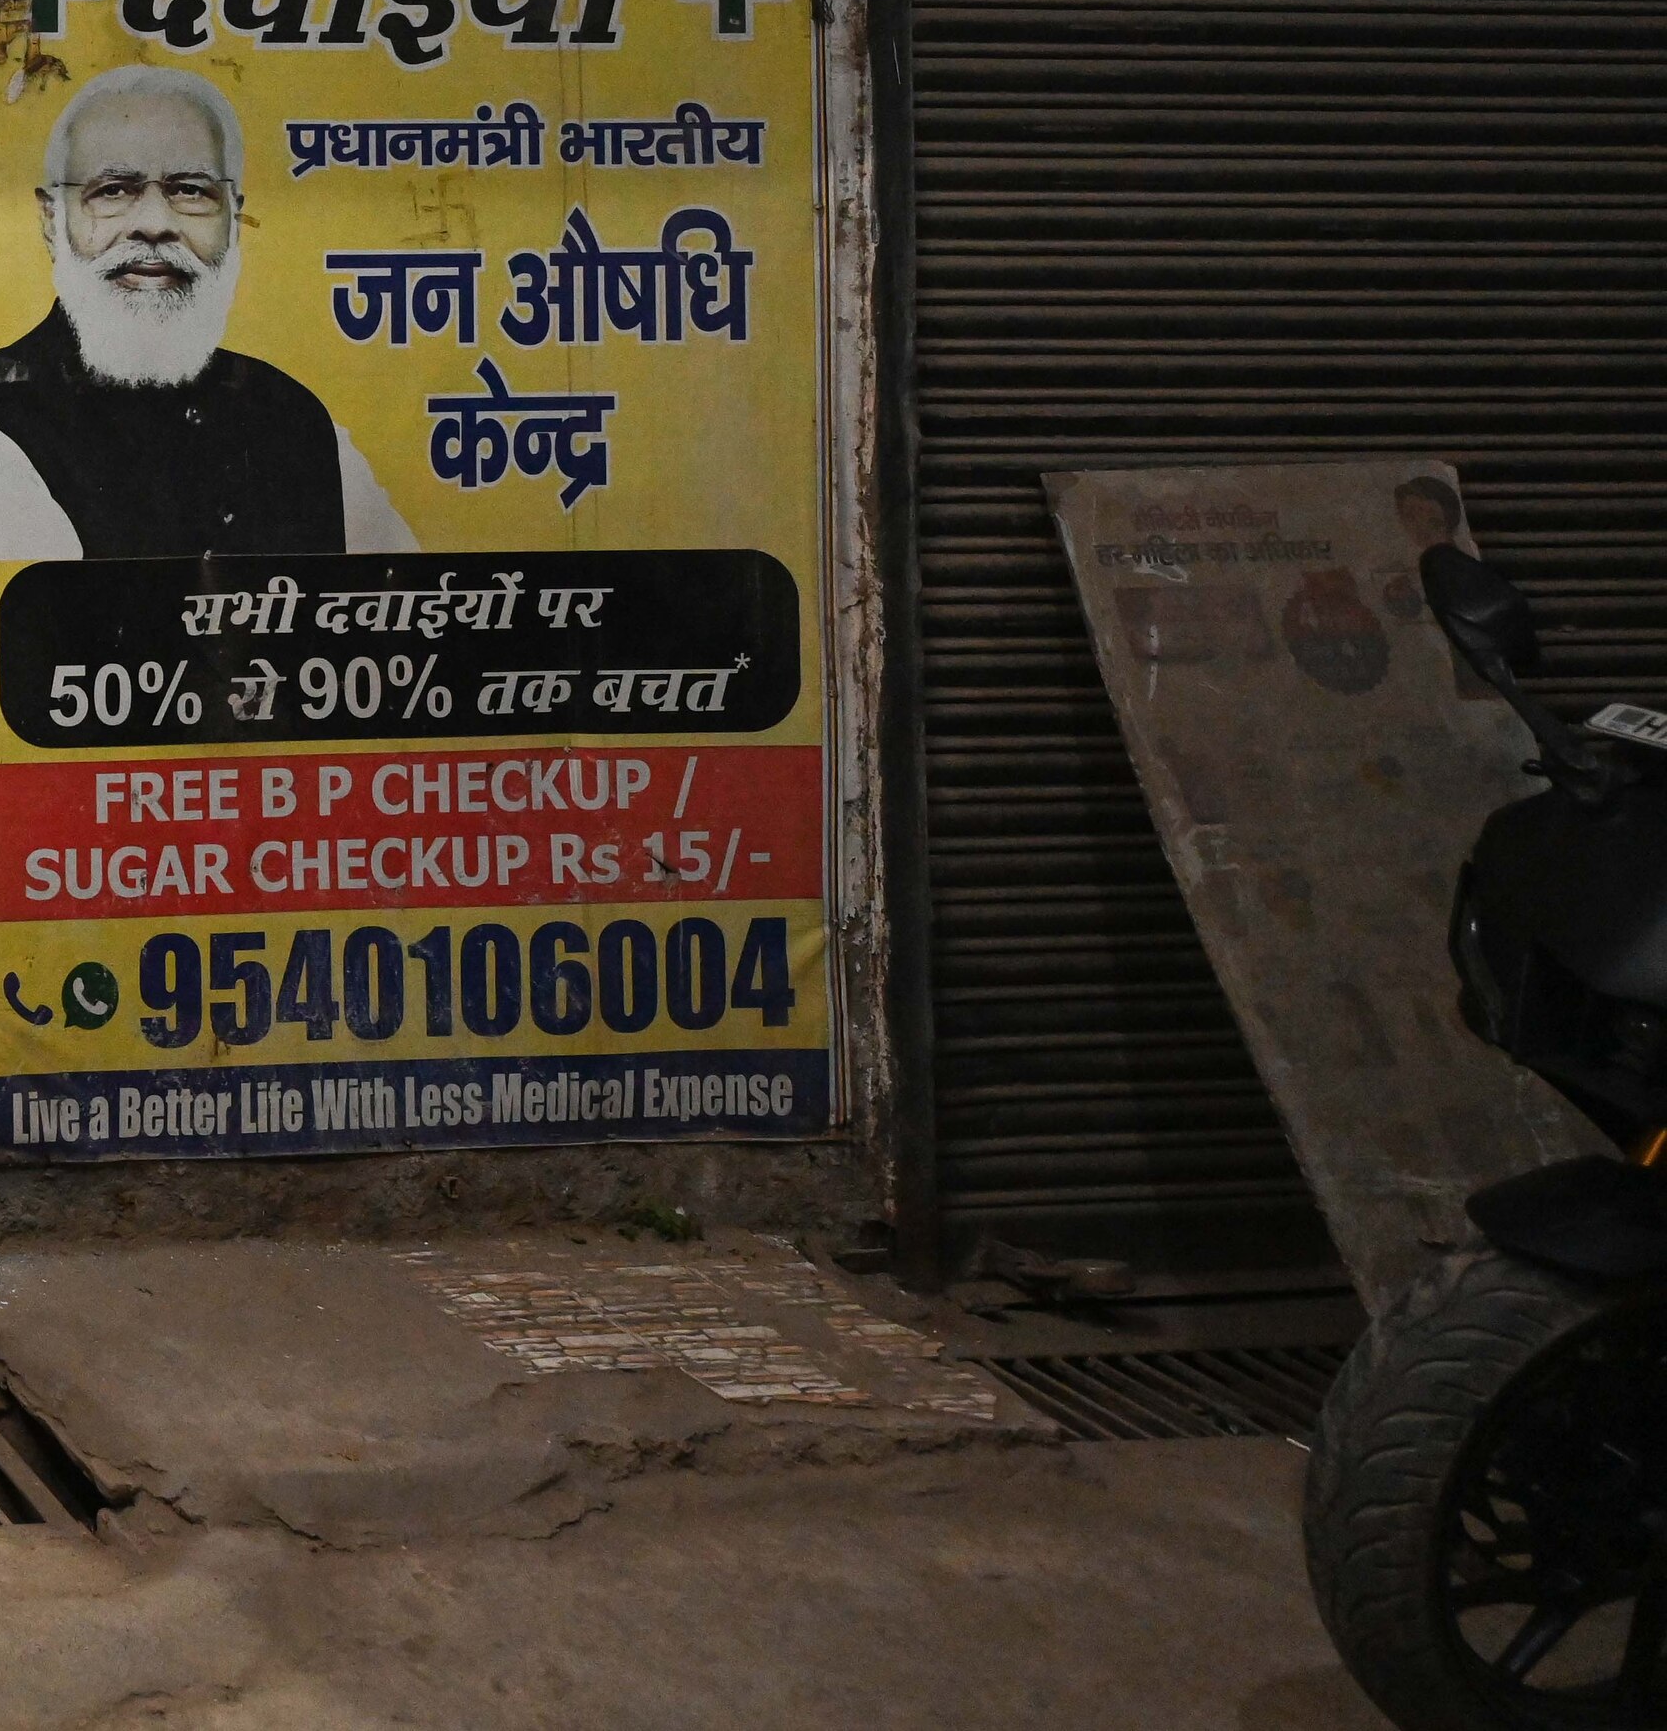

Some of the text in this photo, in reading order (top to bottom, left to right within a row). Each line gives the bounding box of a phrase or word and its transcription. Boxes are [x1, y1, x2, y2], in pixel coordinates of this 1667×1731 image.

[286, 101, 766, 176] प्रधानमंत्री भारतीय
[325, 206, 753, 347] जन औषधि
[427, 357, 616, 509] केन्द्र
[182, 571, 614, 642] सभी दवाईयों पर
[50, 658, 204, 728] 50%
[299, 653, 454, 722] 90%
[478, 668, 580, 717] तक
[94, 769, 243, 824] FREE
[262, 768, 298, 819] B
[319, 766, 354, 817] P
[371, 758, 651, 814] CHECKUP
[24, 827, 772, 902] SUGAR CHECKUP Rs 15/-
[139, 917, 796, 1049] 9540106004
[12, 1067, 795, 1145] Live a Better Life With Less Medical Expense
